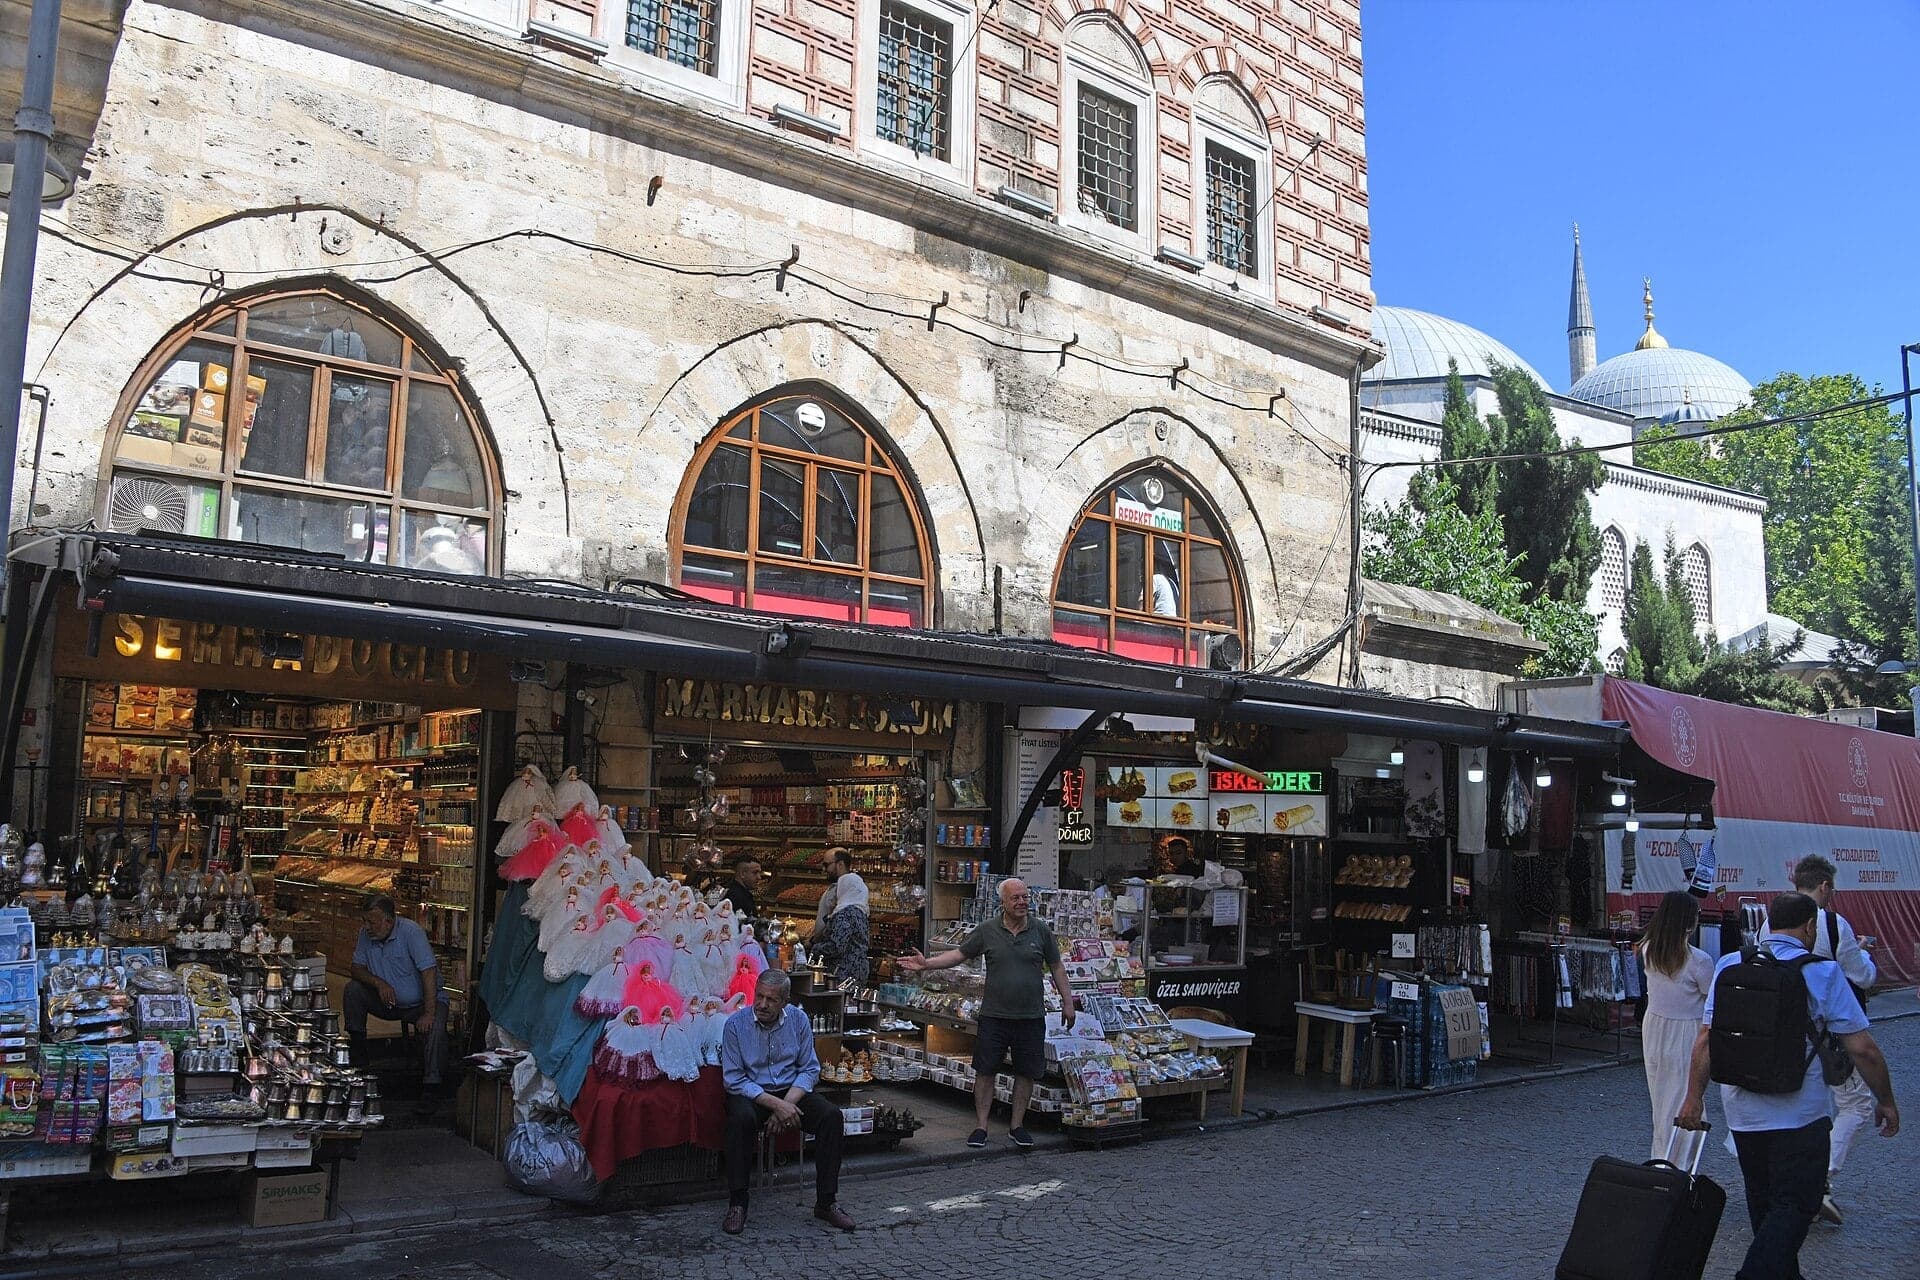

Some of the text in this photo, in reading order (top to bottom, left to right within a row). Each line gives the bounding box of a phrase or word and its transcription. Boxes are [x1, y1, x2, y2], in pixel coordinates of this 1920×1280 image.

[664, 677, 840, 727] MARMARA
[1068, 811, 1083, 825] ET
[1058, 826, 1092, 841] DÖNER
[1156, 978, 1241, 999] ÖZEL SANDVİÇLER
[1452, 1011, 1471, 1033] SU
